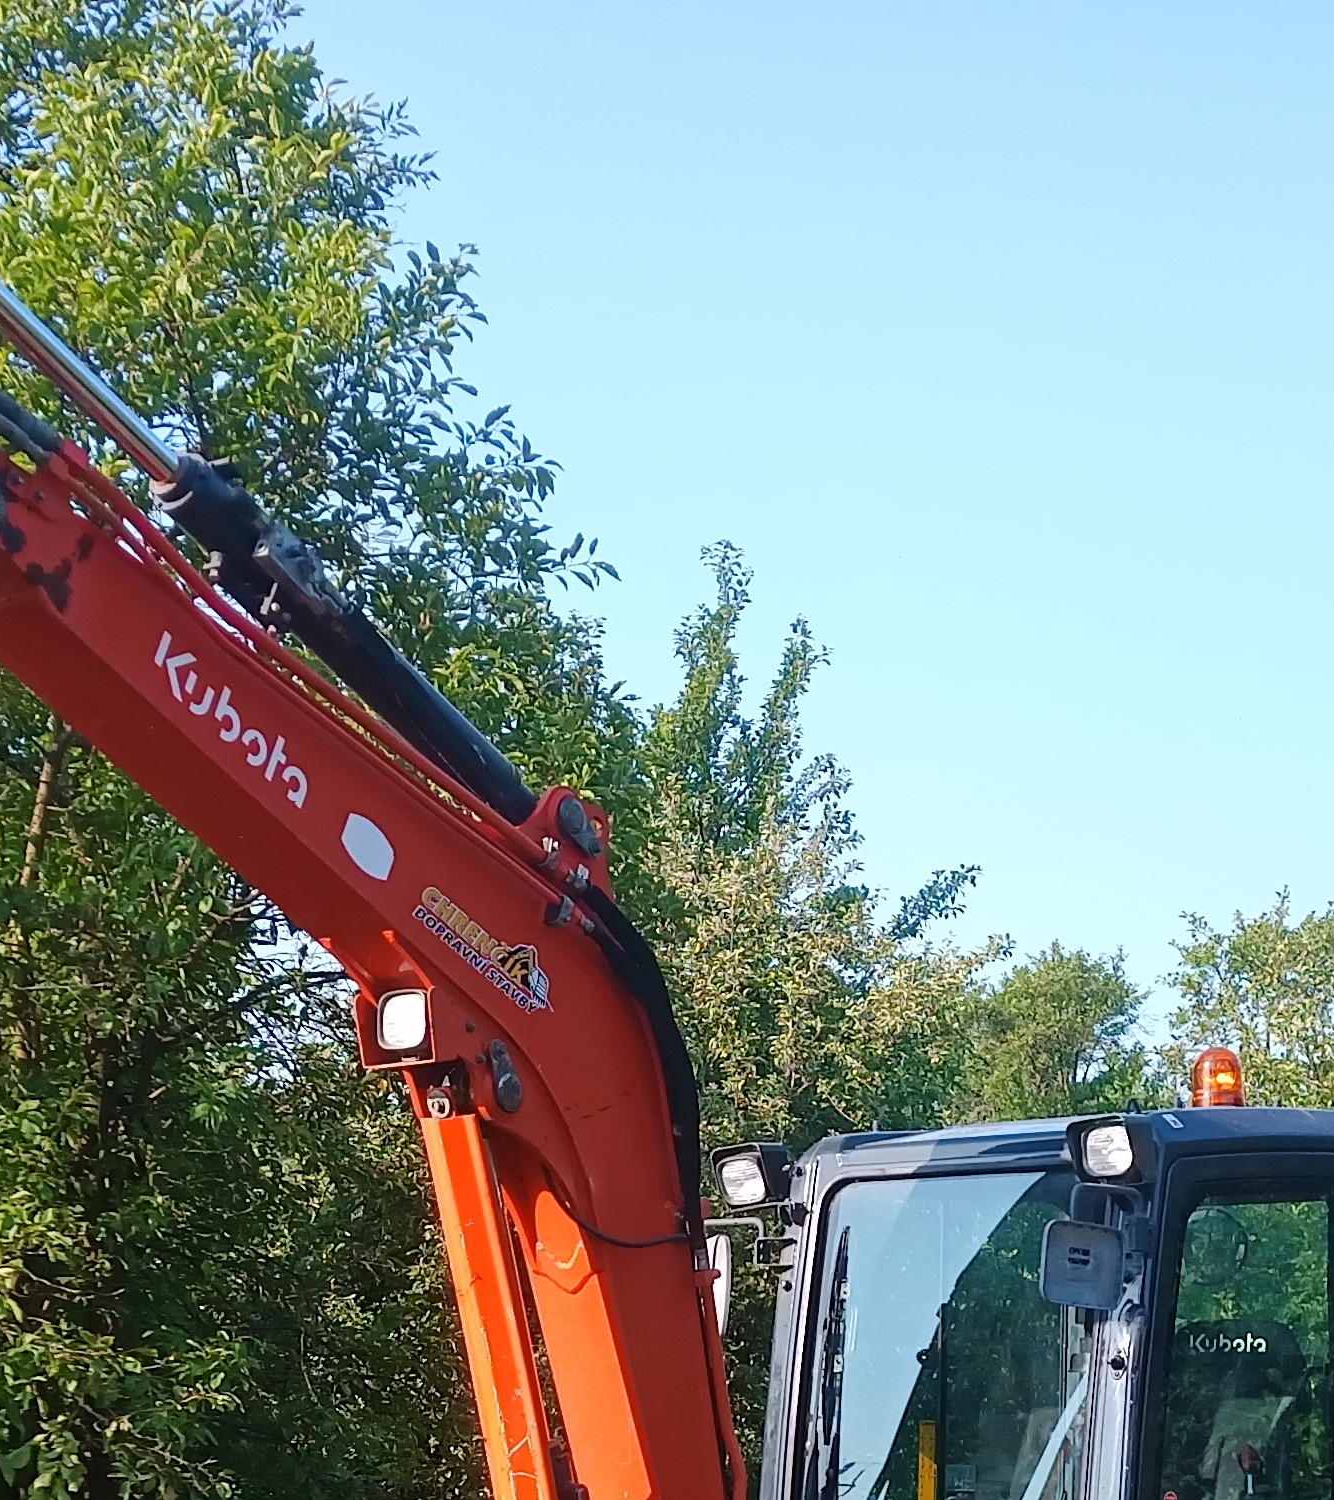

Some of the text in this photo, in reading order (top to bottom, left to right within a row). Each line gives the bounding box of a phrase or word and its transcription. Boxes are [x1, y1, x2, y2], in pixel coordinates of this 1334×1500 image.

[154, 630, 309, 809] Kubota
[413, 906, 539, 1014] DOPRAVNÍ STAVBY
[1189, 1332, 1267, 1353] Kubota
